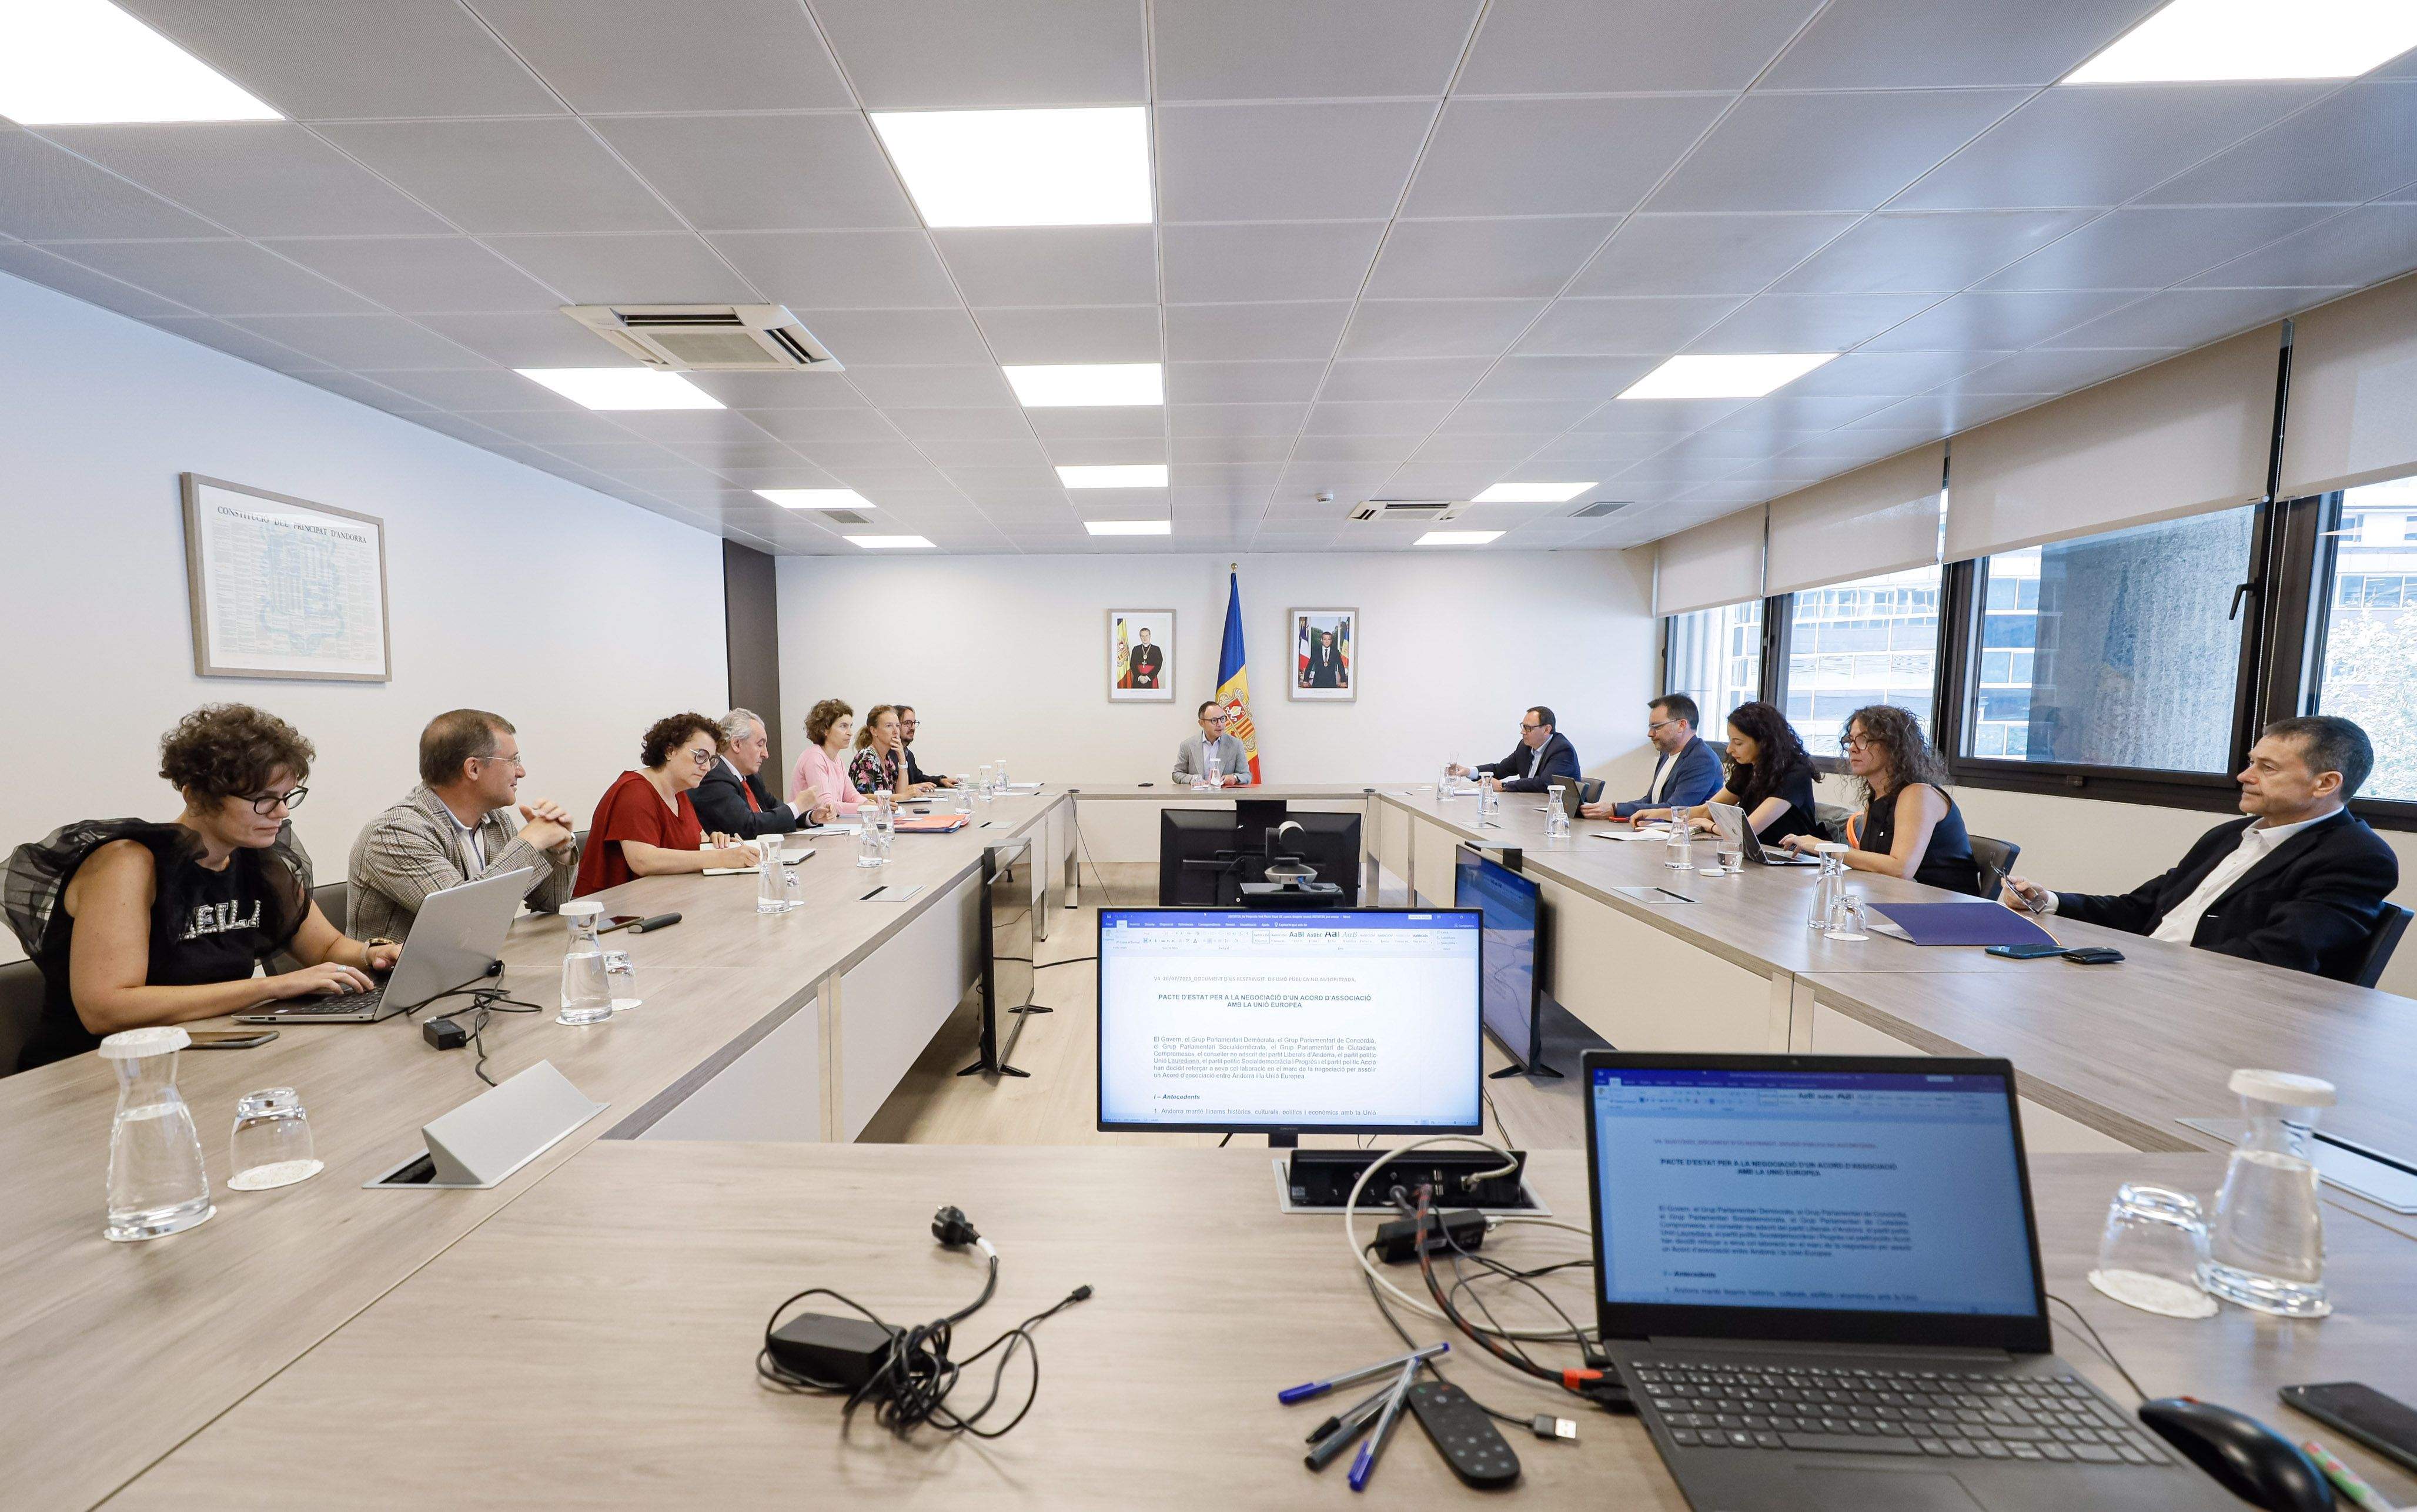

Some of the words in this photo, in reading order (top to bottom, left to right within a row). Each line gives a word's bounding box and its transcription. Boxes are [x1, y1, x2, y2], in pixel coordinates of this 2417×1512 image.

[273, 517, 289, 527] DEL
[293, 523, 327, 536] PRINCIPAT
[331, 529, 367, 543] D'ANDORRA
